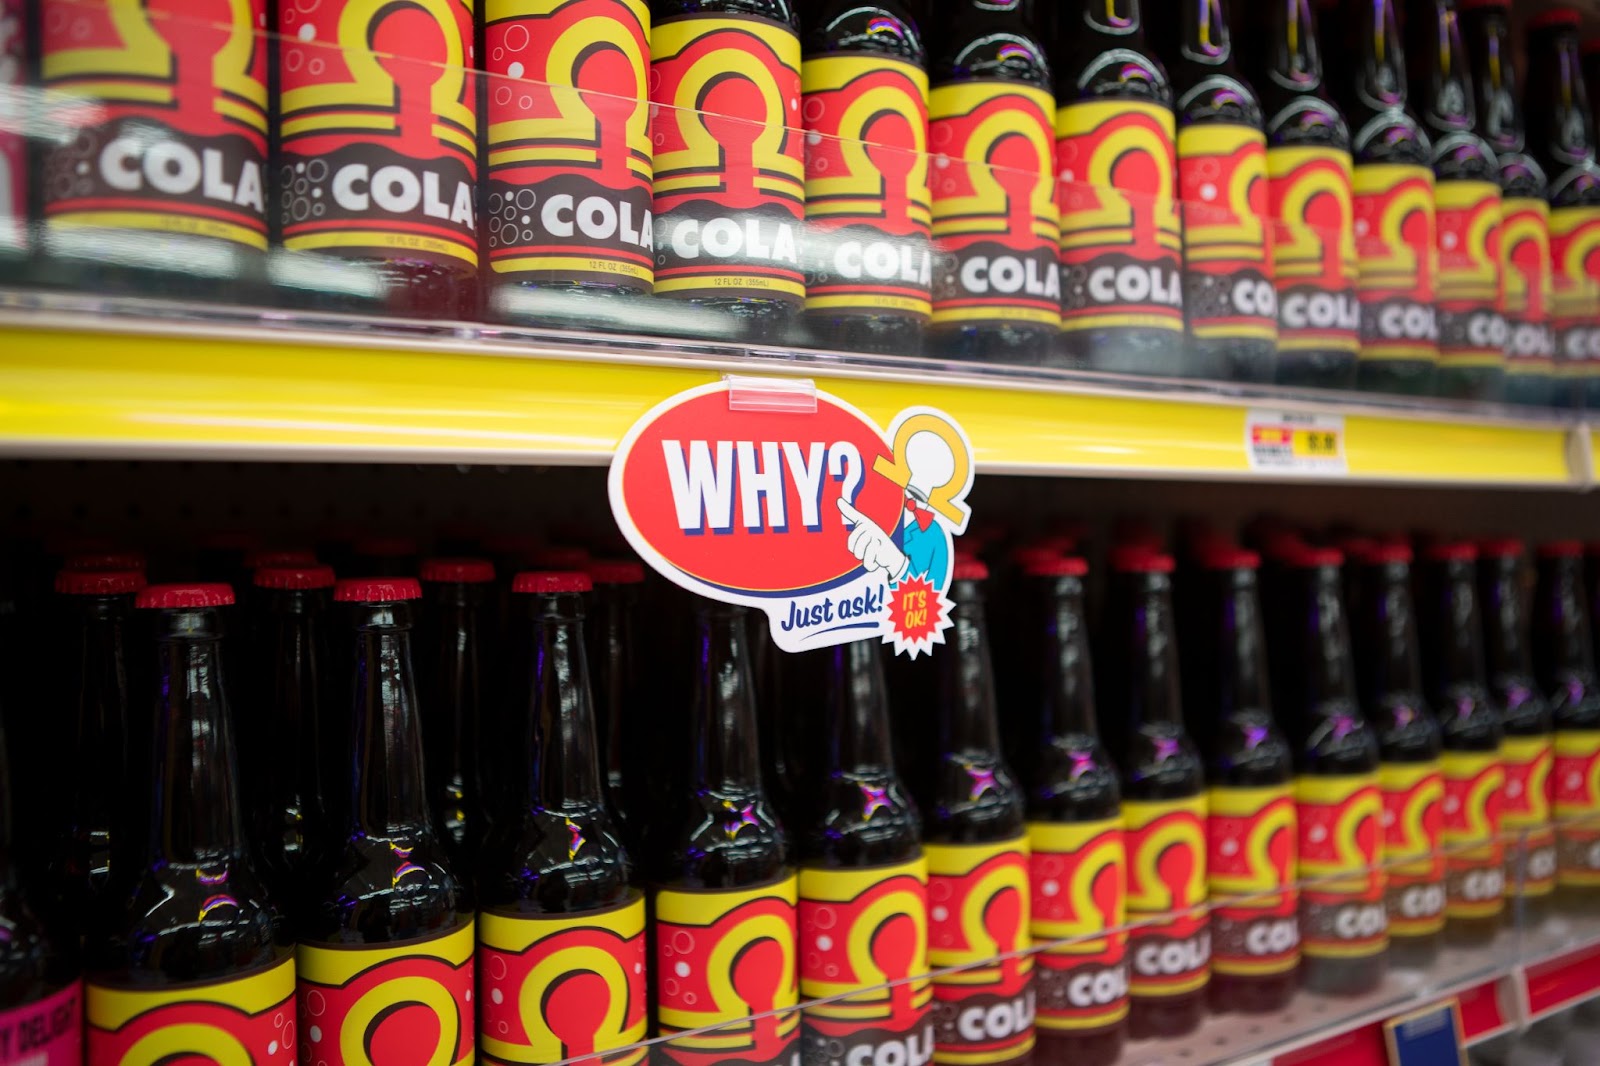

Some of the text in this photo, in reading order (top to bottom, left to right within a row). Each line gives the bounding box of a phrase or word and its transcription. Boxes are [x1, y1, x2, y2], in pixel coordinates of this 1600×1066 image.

[100, 138, 265, 212] COLA
[332, 163, 475, 230] COLA
[541, 193, 653, 253] COLA
[671, 217, 798, 264] COLA
[589, 261, 597, 269] 12
[598, 262, 606, 270] FL
[608, 263, 617, 271] OZ
[714, 278, 722, 286] 12
[723, 278, 732, 286] FL
[733, 278, 743, 286] OZ
[661, 439, 866, 536] WHY?
[781, 584, 884, 631] Just ask!
[903, 589, 927, 609] IT'S
[905, 609, 928, 629] OK!
